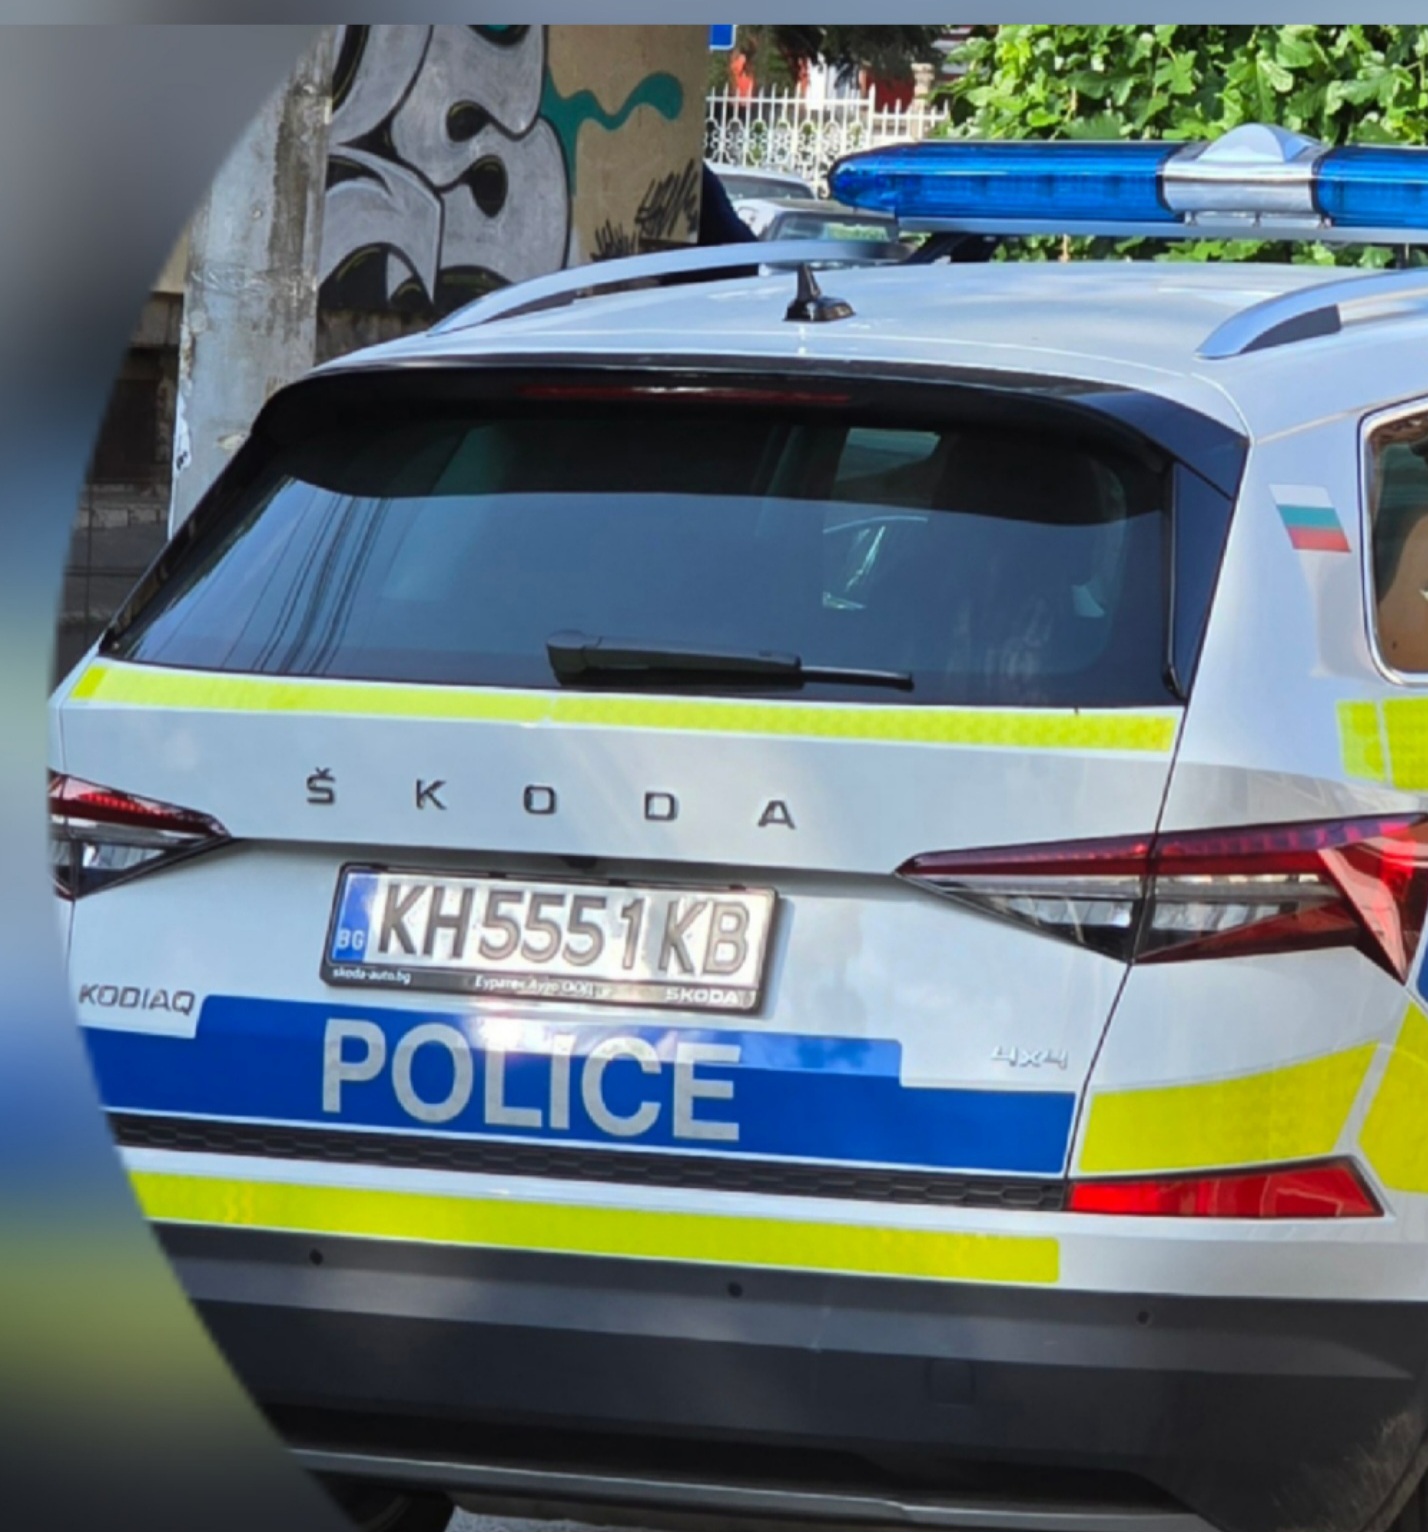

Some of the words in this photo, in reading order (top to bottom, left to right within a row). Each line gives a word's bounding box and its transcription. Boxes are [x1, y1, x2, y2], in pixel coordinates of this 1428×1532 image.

[306, 768, 796, 829] ŠKODA
[336, 928, 364, 951] BG
[332, 967, 411, 985] skoda-auto.bg
[78, 983, 196, 1017] KODIAQ
[321, 1018, 740, 1142] POLICE
